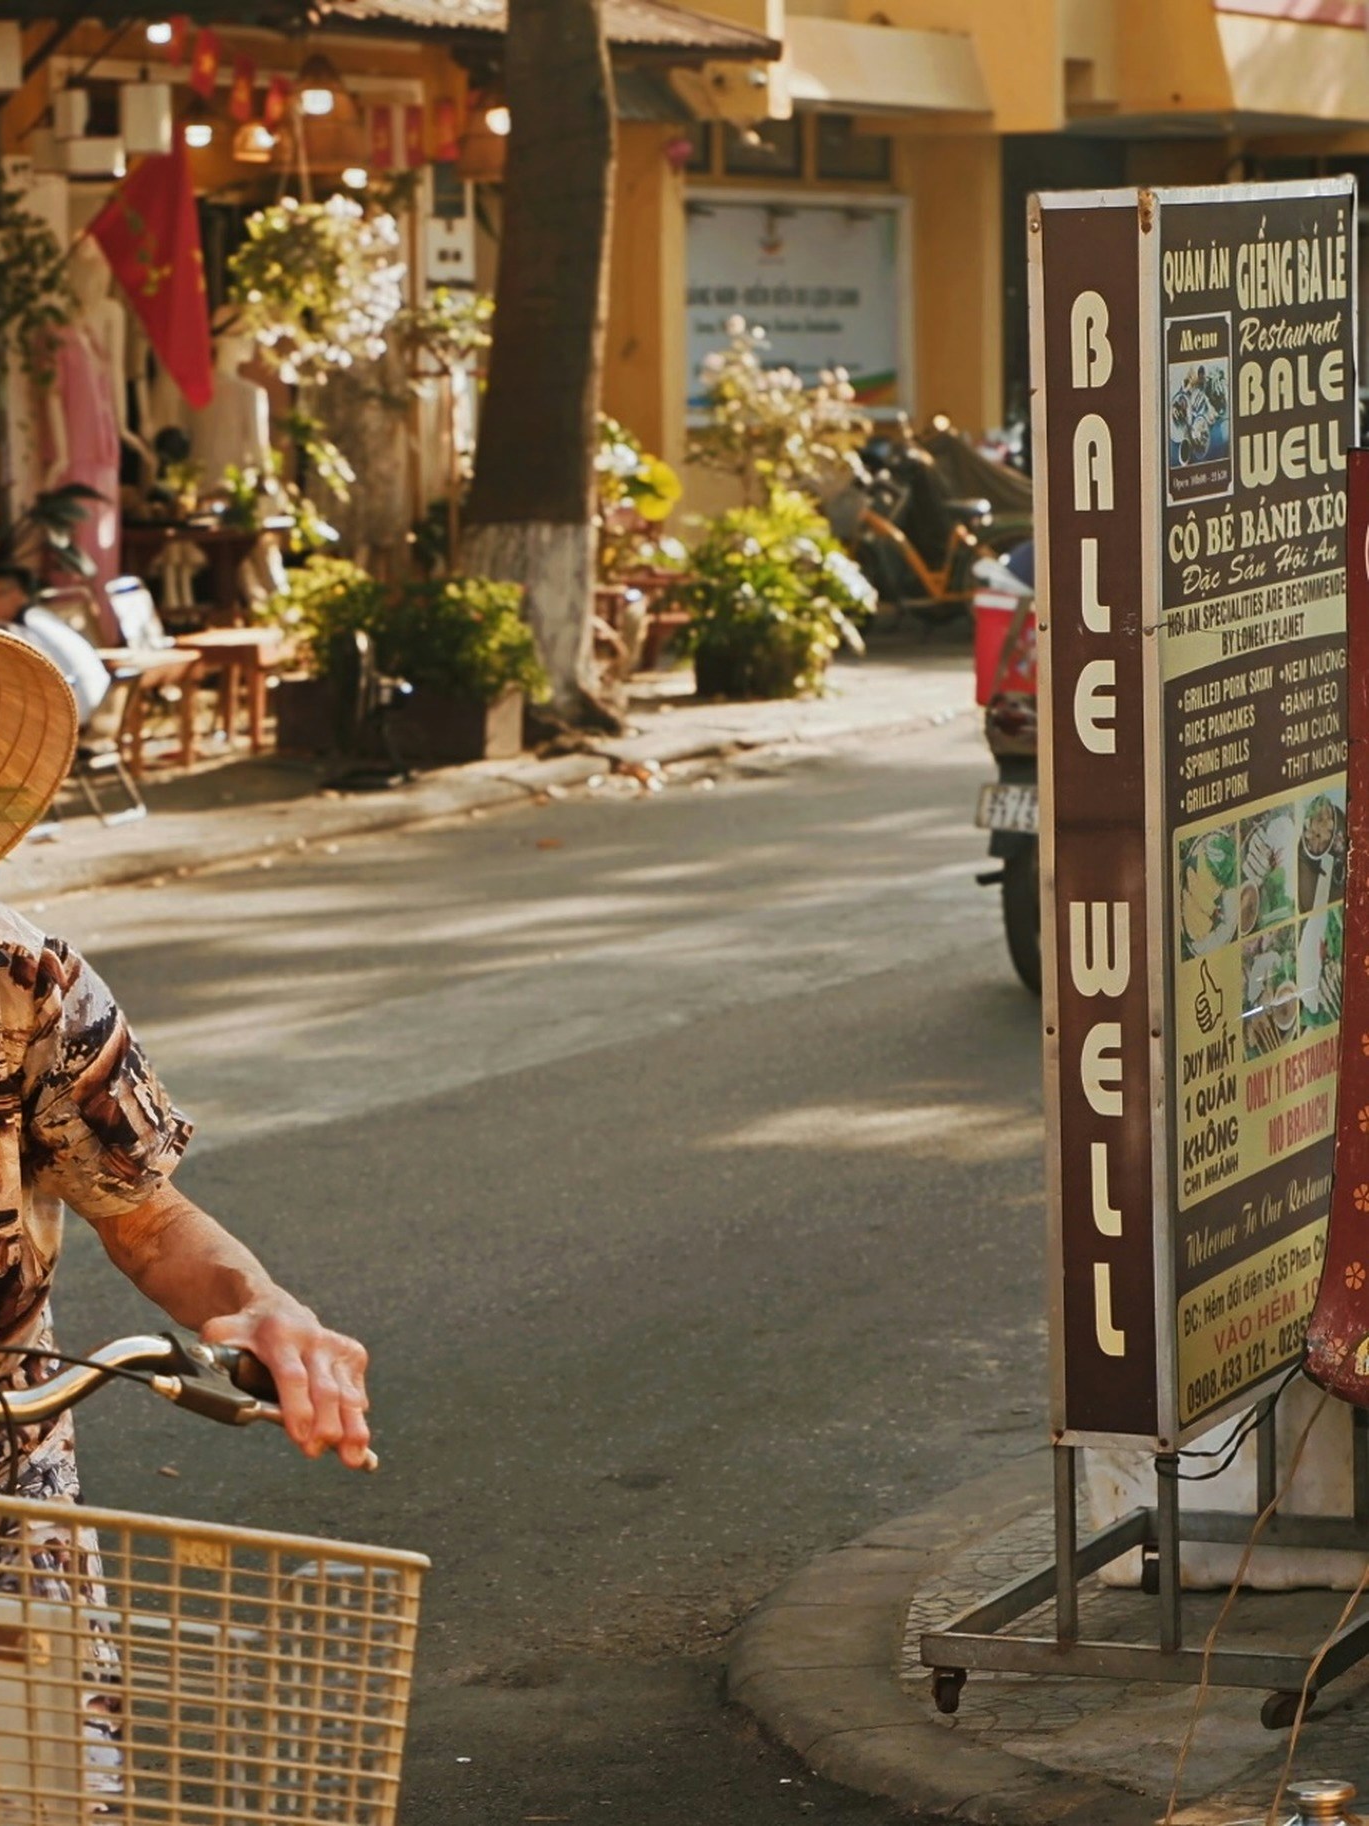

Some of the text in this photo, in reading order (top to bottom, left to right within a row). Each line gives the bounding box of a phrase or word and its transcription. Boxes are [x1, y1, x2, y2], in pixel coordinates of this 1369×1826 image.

[1163, 240, 1205, 303] QUÁN
[1236, 215, 1294, 310] GIẾNG
[1180, 329, 1218, 352] Menu
[1239, 312, 1341, 356] Restaurant
[1239, 350, 1344, 417] BALE
[1239, 420, 1347, 488] WELL
[1168, 483, 1346, 564] CÔ BÉ BÁNH XÈO
[1182, 536, 1340, 597] Đặc Sản Hội An
[1187, 608, 1201, 631] AN
[1203, 592, 1263, 630] SPECIALITIES
[1266, 587, 1283, 612] ARE
[1222, 612, 1305, 656] BY LONELY PLANET
[1184, 681, 1220, 713] GRILLED
[1223, 673, 1247, 702] PORK
[1284, 658, 1308, 685] NEM
[1285, 678, 1338, 716] BÁNH XÈO
[1184, 703, 1256, 747] RICE PANCAKES
[1286, 725, 1308, 747] RAM
[1185, 737, 1250, 780] SPRING ROLLS
[1186, 770, 1250, 813] GRILLED PORK
[1069, 290, 1130, 1356] BALE WELL
[1183, 1048, 1205, 1085] DUY
[1246, 1065, 1272, 1113] ONLY
[1285, 1034, 1339, 1095] RESTAURA
[1184, 1072, 1236, 1123] 1 QUÁN
[1183, 1115, 1238, 1171] KHÔNG
[1268, 1091, 1328, 1157] NO BRANCH
[1183, 1152, 1238, 1197] CHI NHÁNH
[1214, 1316, 1252, 1354] VÀO
[1246, 1338, 1266, 1376] 121
